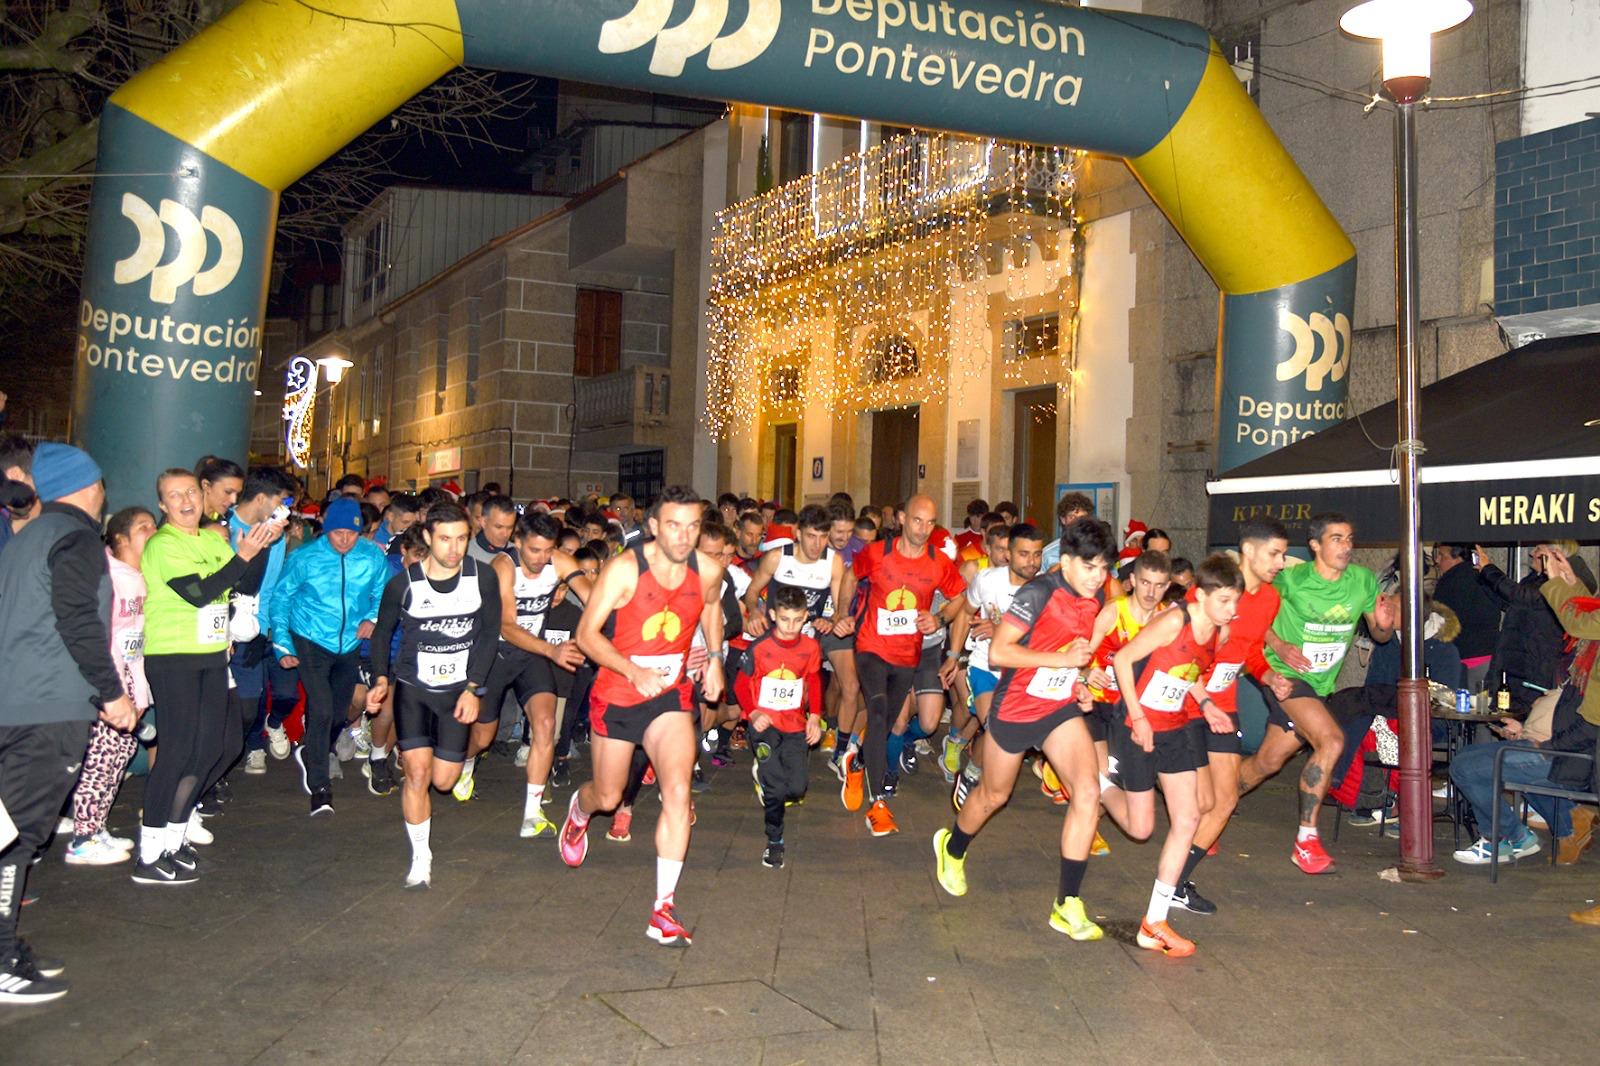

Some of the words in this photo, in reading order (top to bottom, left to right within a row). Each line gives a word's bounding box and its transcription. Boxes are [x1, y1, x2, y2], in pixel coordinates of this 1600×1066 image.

[804, 28, 1084, 106] Pontevedra
[80, 300, 260, 349] Deputación
[77, 335, 257, 383] Pontevedra
[1239, 396, 1344, 426] Deputac
[1480, 493, 1574, 525] MERAKI
[213, 616, 226, 629] 87
[886, 616, 908, 627] 190
[1313, 652, 1334, 663] 131
[430, 663, 456, 675] 163
[772, 687, 795, 699] 184
